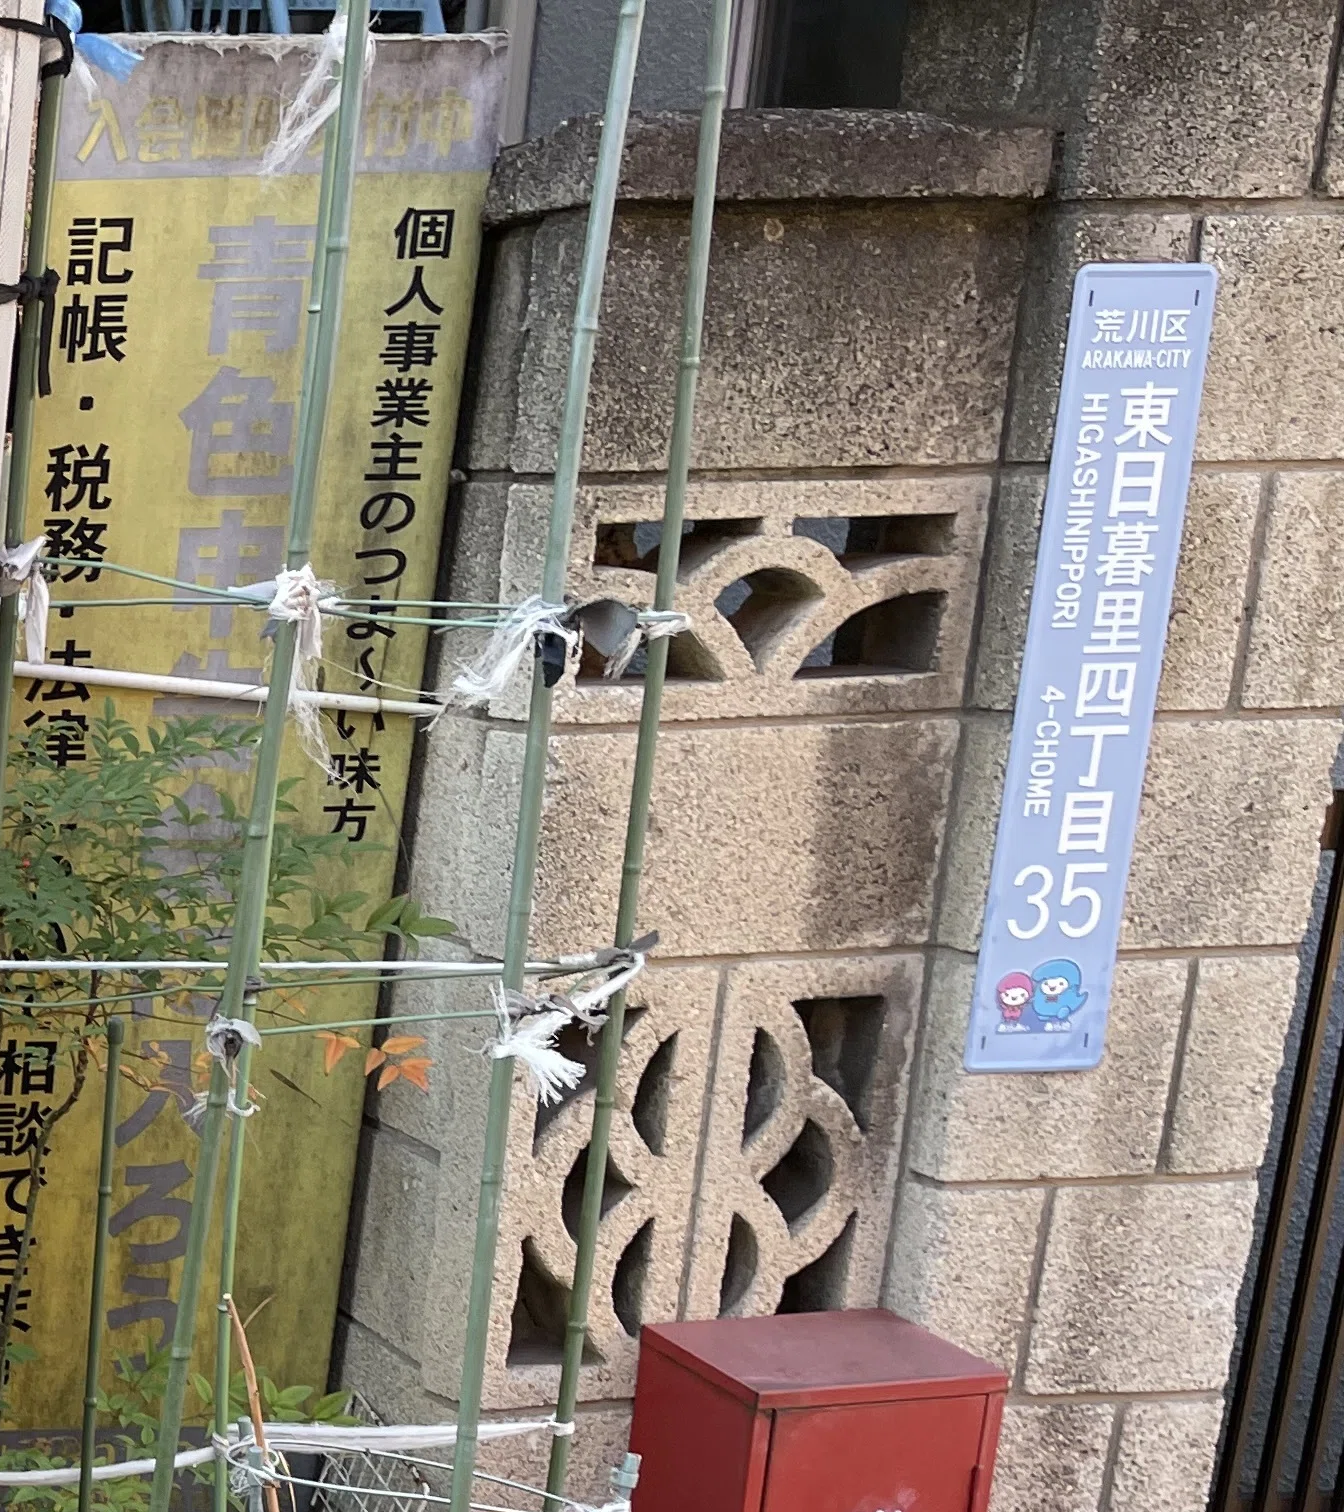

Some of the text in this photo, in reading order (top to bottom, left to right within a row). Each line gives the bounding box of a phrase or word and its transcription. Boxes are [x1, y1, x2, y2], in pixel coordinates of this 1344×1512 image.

[1091, 309, 1192, 343] 荒川区
[1023, 393, 1110, 818] HIGASHINIPPORI 4-CHOME
[1057, 381, 1179, 855] 東日暮里四丁目
[1006, 862, 1108, 940] 35
